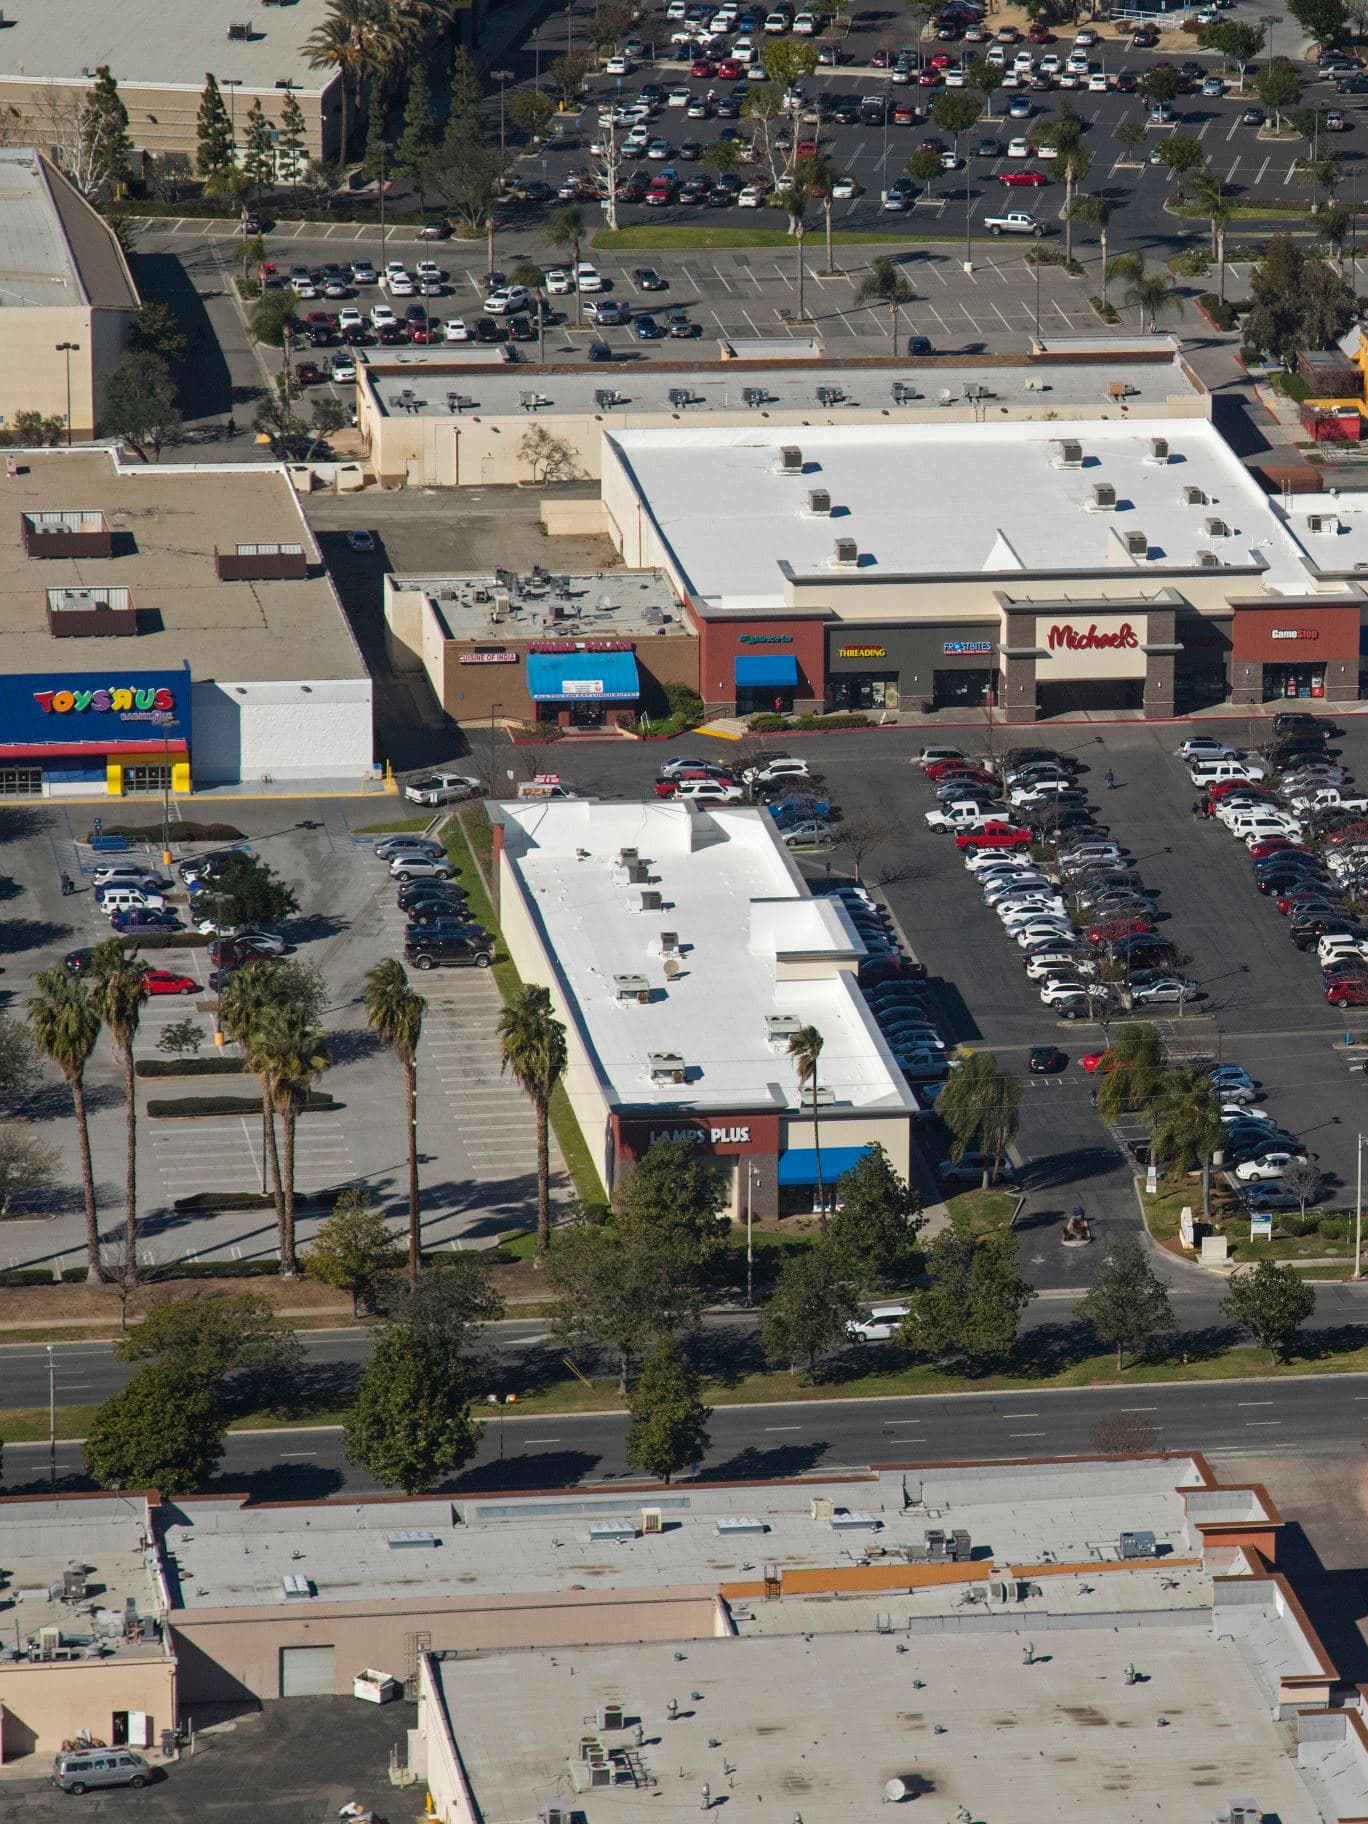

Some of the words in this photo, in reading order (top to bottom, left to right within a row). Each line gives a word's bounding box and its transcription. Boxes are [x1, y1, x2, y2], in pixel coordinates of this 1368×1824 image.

[1047, 623, 1139, 650] Michaels
[1271, 629, 1318, 639] GameStop
[943, 641, 991, 650] FROSTBITES
[498, 653, 516, 661] INDIA
[839, 649, 885, 657] THREADING
[650, 1129, 705, 1145] LAMPS
[710, 1127, 749, 1142] PLUS
